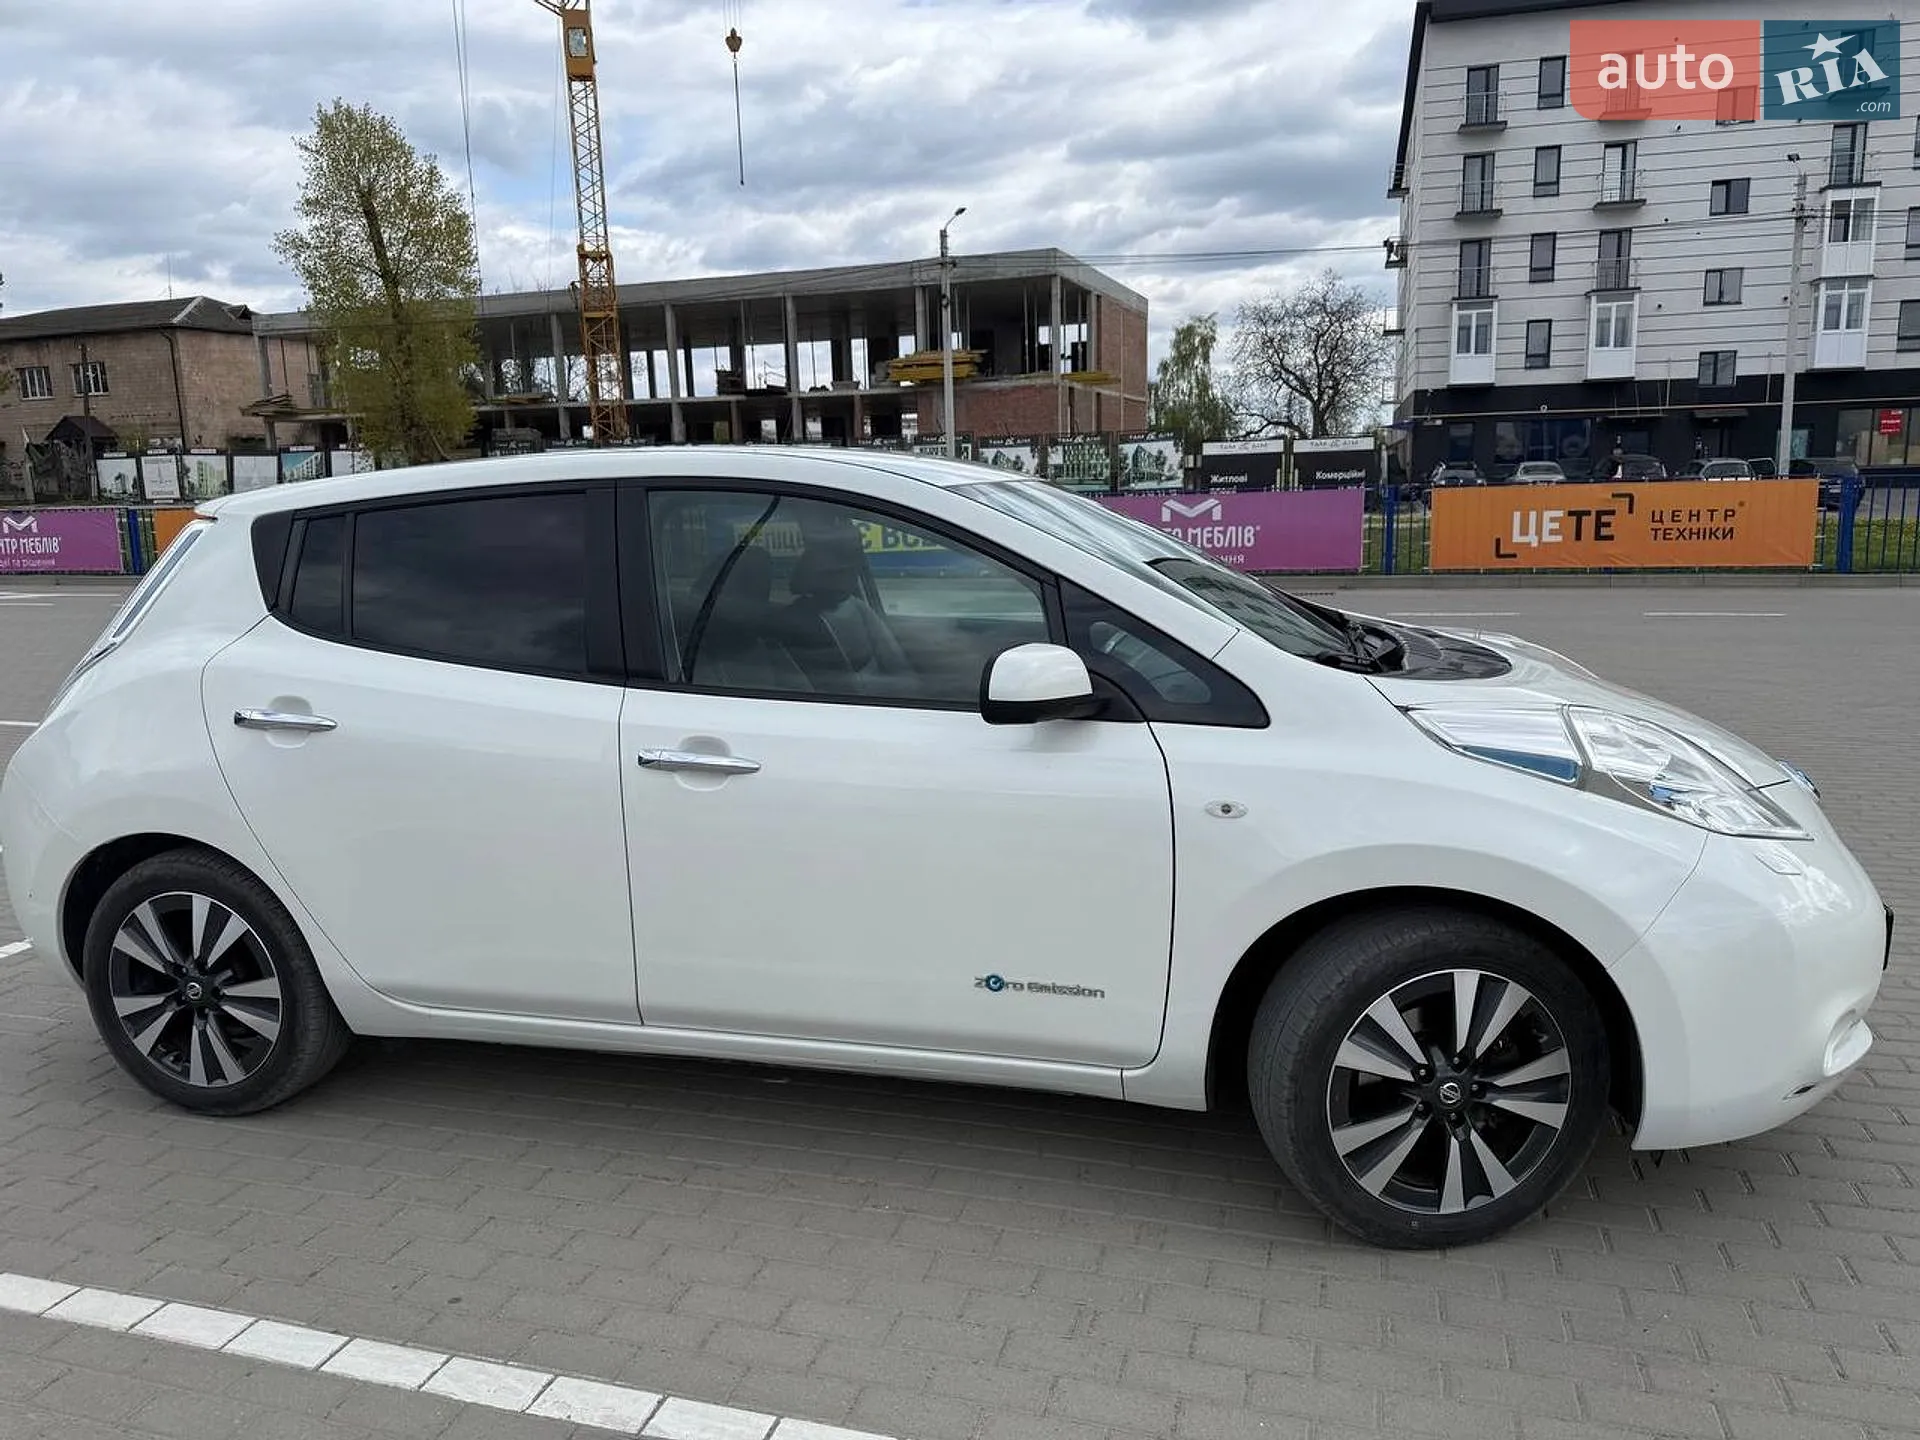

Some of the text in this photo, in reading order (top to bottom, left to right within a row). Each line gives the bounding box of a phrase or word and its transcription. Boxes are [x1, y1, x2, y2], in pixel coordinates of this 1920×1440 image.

[1651, 508, 1736, 524] ЦЕНТР
[1511, 508, 1616, 547] ЦЕТЕ
[1650, 526, 1735, 541] ТЕХНІКИ
